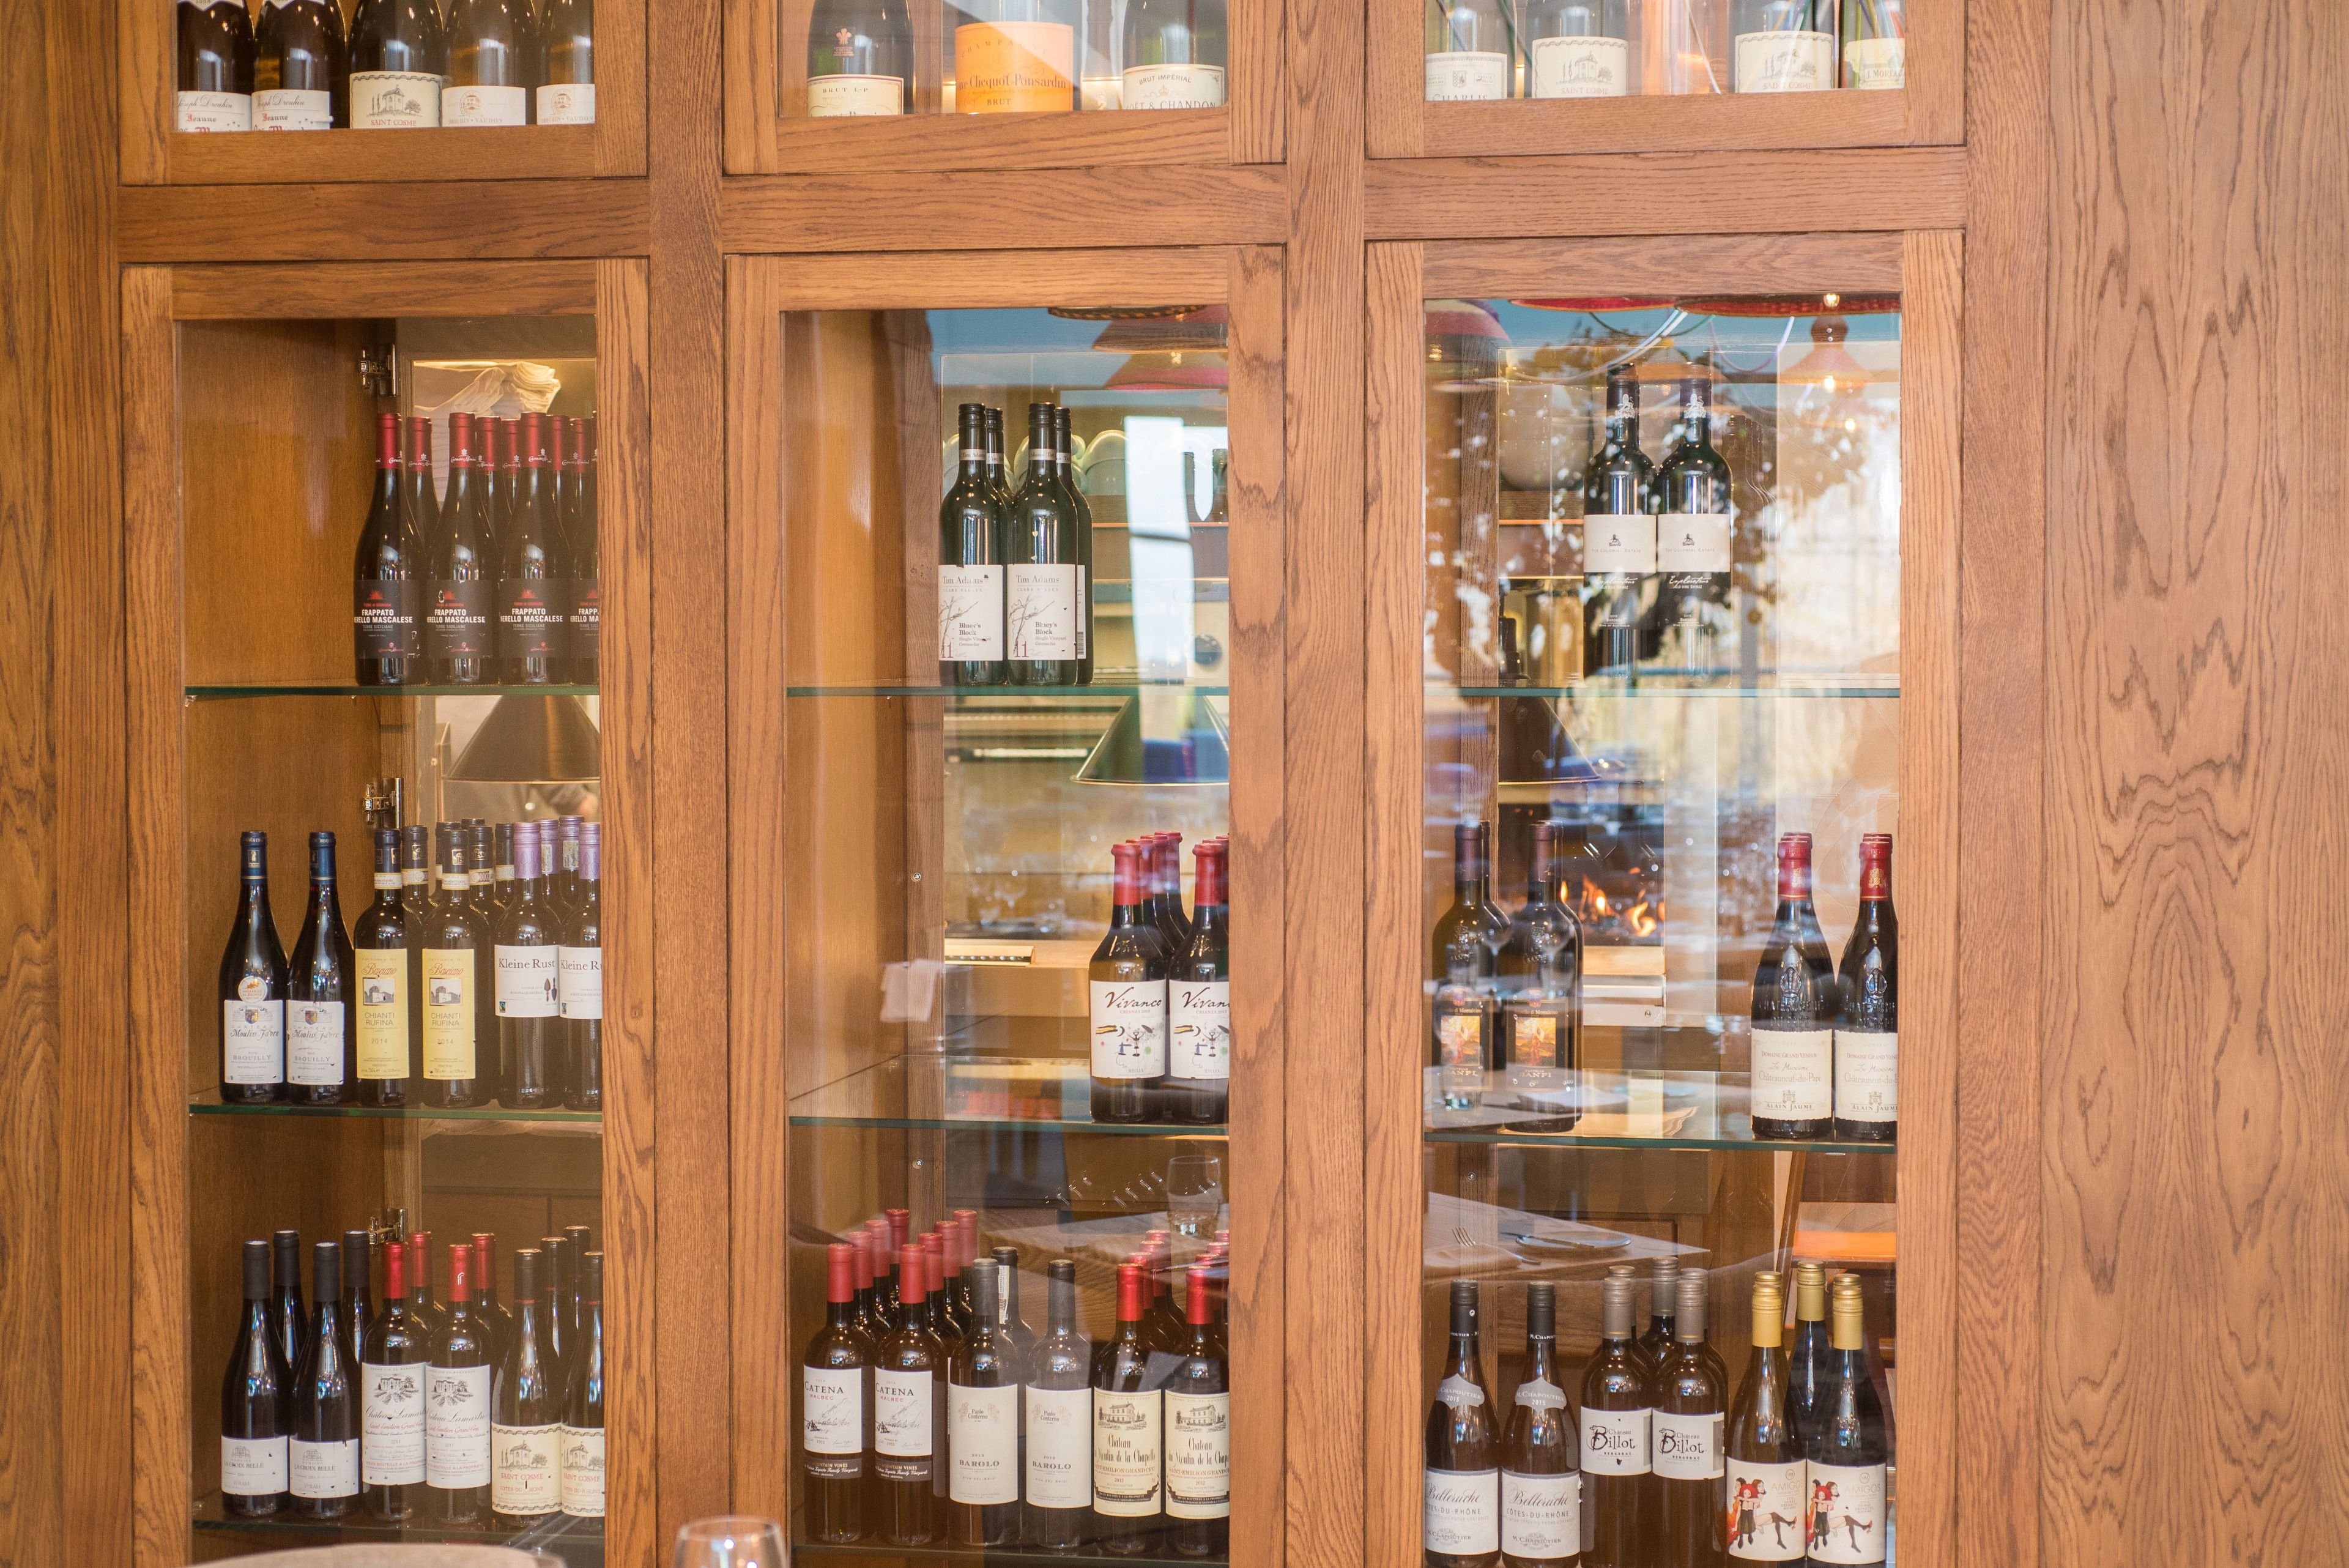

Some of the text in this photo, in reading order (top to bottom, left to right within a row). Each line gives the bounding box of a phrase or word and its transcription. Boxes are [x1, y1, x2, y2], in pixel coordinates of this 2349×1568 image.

[970, 73, 1066, 89] Clicquot Ponsardin
[1139, 74, 1192, 85] BRUT IMPÉRIAL
[199, 94, 232, 108] Drouhin
[273, 92, 305, 106] Drouhin
[1160, 100, 1215, 110] CHANDON
[393, 119, 417, 127] COSME
[943, 576, 954, 584] Tim
[1016, 574, 1030, 584] Tim
[499, 958, 555, 968] Kleine Rust
[561, 959, 588, 970] Kleine
[1105, 986, 1162, 1008] Vivanco
[230, 1029, 256, 1038] Moulin
[292, 1030, 316, 1038] Moulin
[1759, 1071, 1821, 1085] Châteauneuf-du-Pape
[1789, 1103, 1813, 1112] JAUME
[805, 1381, 844, 1394] CATENA
[875, 1383, 915, 1396] CATENA
[1588, 1425, 1636, 1451] Billot
[1657, 1429, 1705, 1455] Billot
[1116, 1450, 1122, 1463] de
[1125, 1449, 1130, 1463] la
[1134, 1448, 1156, 1466] Chapelle
[1174, 1452, 1195, 1467] Moulin
[1198, 1453, 1203, 1465] de
[1206, 1452, 1212, 1465] la
[1032, 1460, 1072, 1470] BAROLO
[1427, 1484, 1480, 1504] Belleruche
[1507, 1483, 1568, 1505] Belleruche
[1844, 1483, 1881, 1494] AMIGOS
[1507, 1507, 1570, 1518] CÔTES-DU-RHÔNE
[1432, 1531, 1472, 1540] CHAPOUTIER
